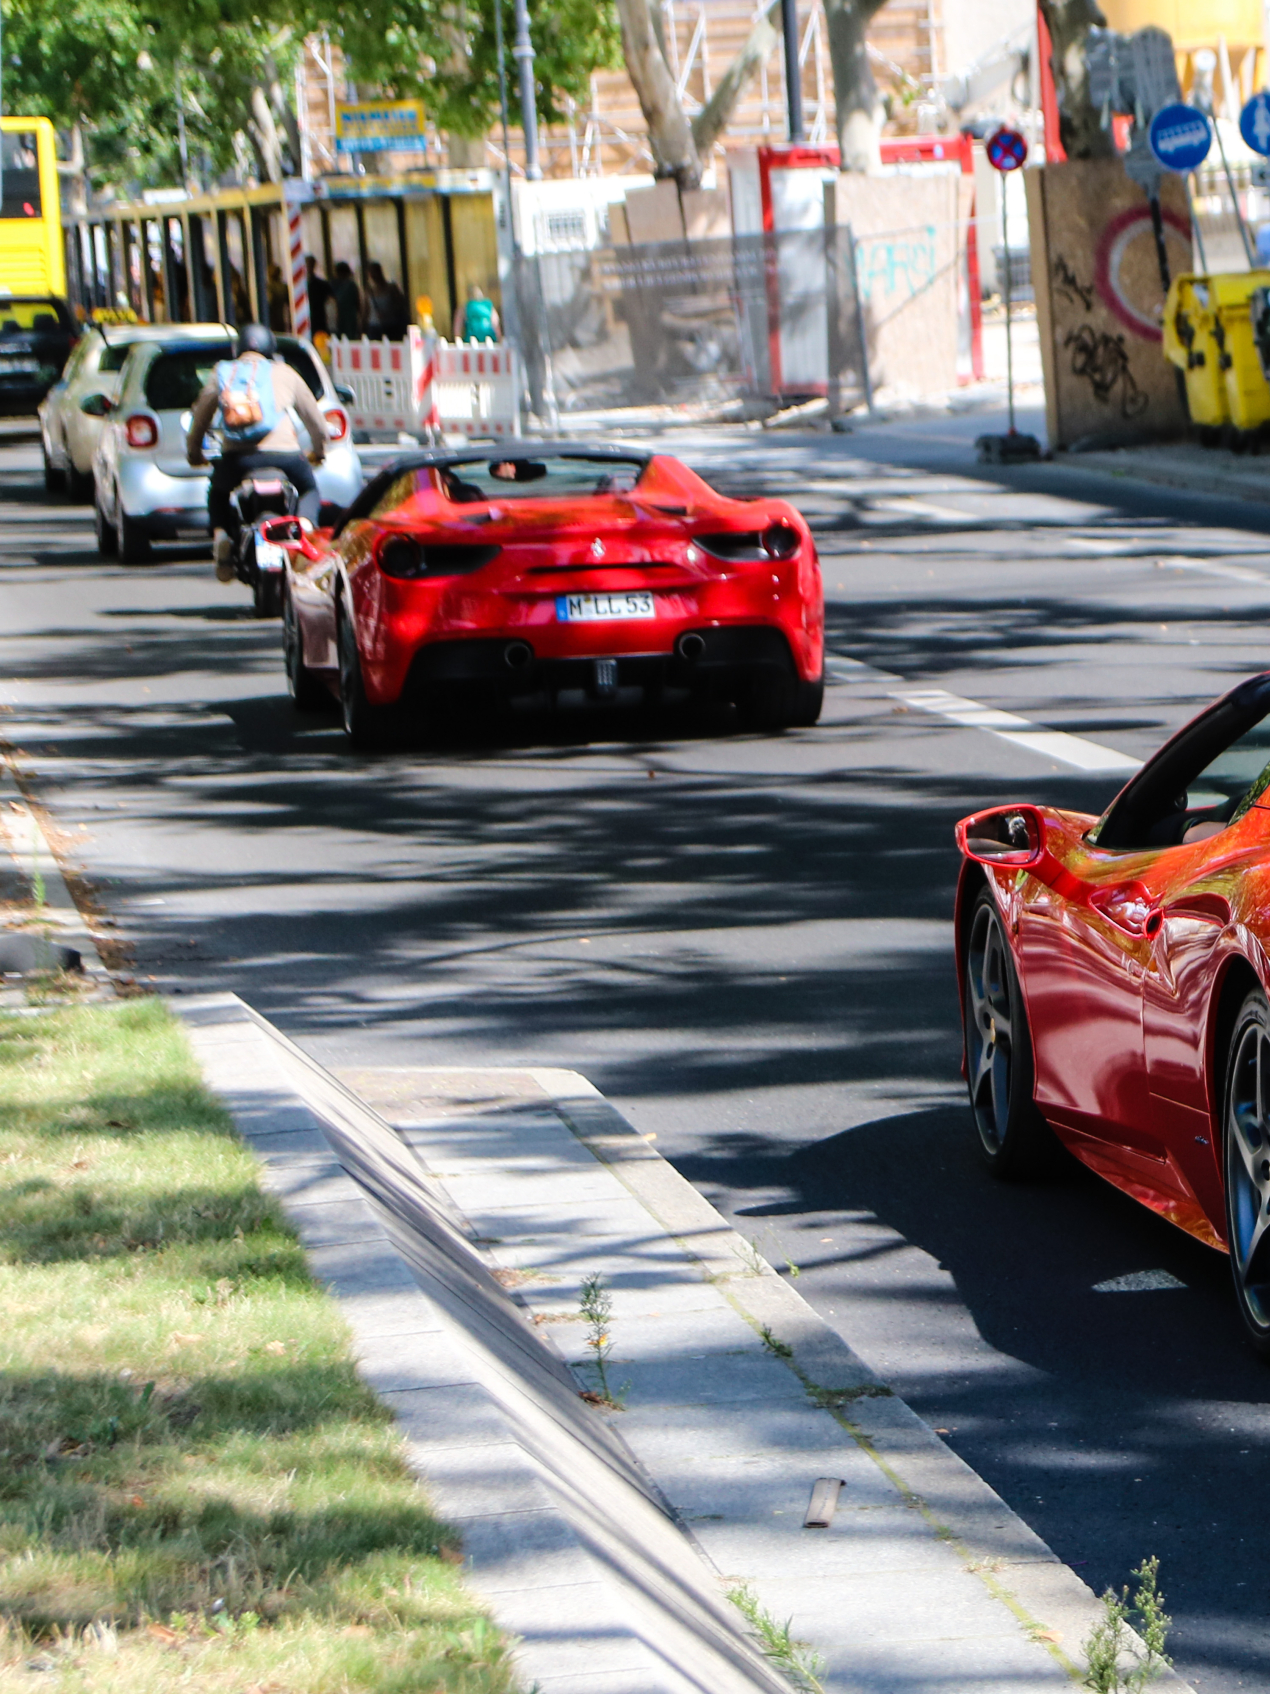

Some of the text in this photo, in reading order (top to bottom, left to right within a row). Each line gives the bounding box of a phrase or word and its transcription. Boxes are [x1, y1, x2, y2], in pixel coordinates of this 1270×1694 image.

[568, 594, 650, 617] M LL 53
